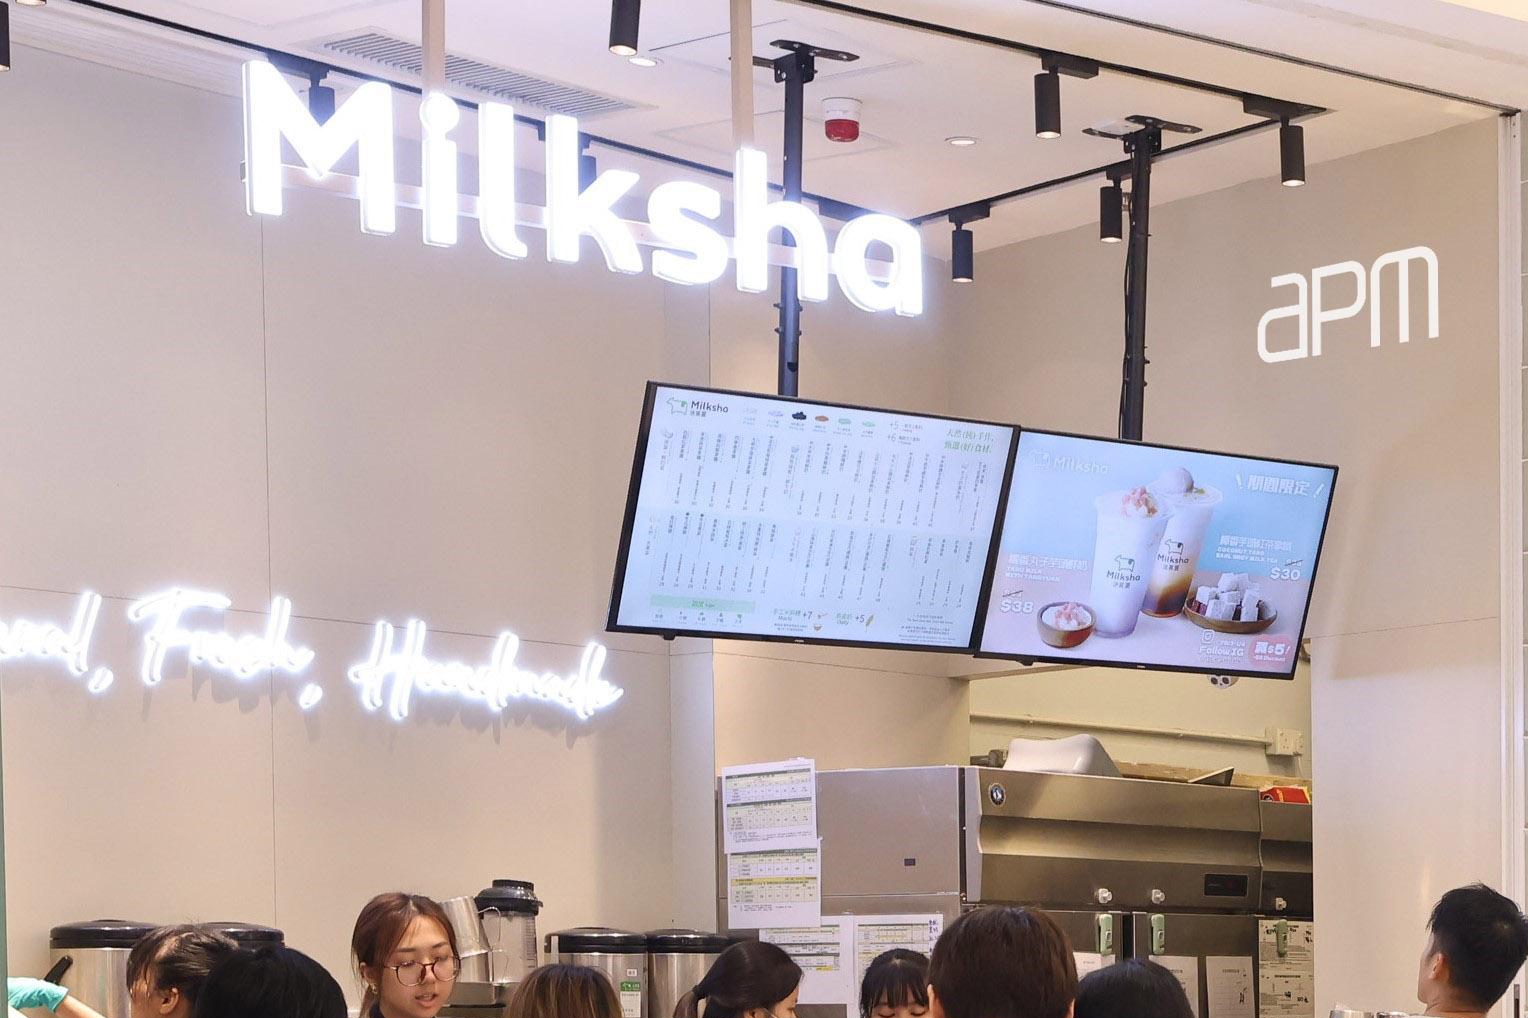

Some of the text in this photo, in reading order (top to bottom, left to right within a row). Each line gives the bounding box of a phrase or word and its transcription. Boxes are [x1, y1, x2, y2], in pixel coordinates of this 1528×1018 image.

[242, 59, 924, 318] Milksha
[1257, 246, 1440, 363] apm
[691, 400, 729, 413] Milksha
[1106, 570, 1141, 582] Milksha
[1270, 567, 1301, 581] $30
[1000, 599, 1034, 614] $38
